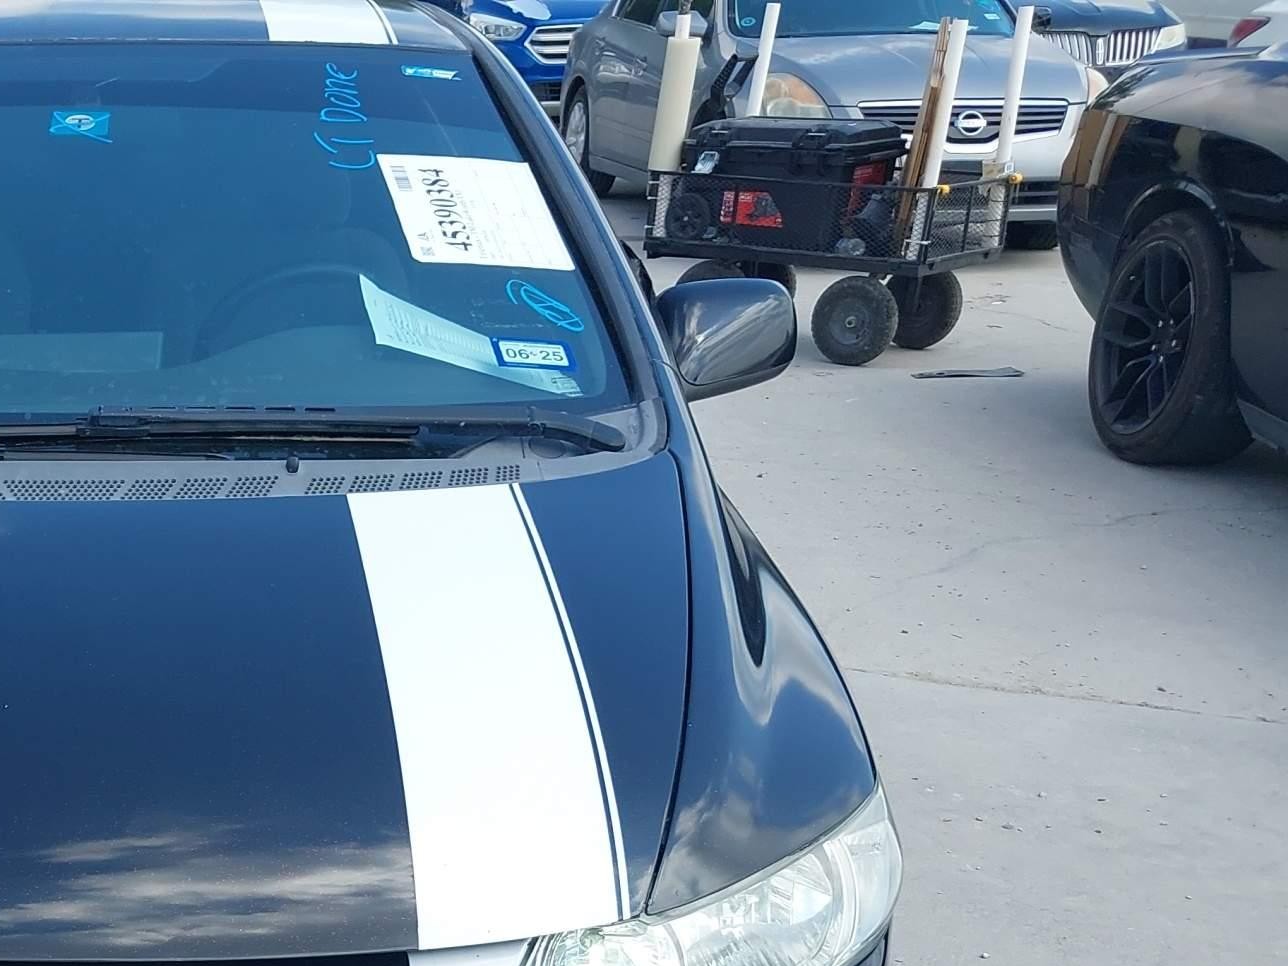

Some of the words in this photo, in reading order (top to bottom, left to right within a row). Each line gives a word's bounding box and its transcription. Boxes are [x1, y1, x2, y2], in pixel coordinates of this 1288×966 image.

[417, 168, 473, 251] 45390384
[505, 347, 530, 360] 06
[539, 349, 564, 362] 25
